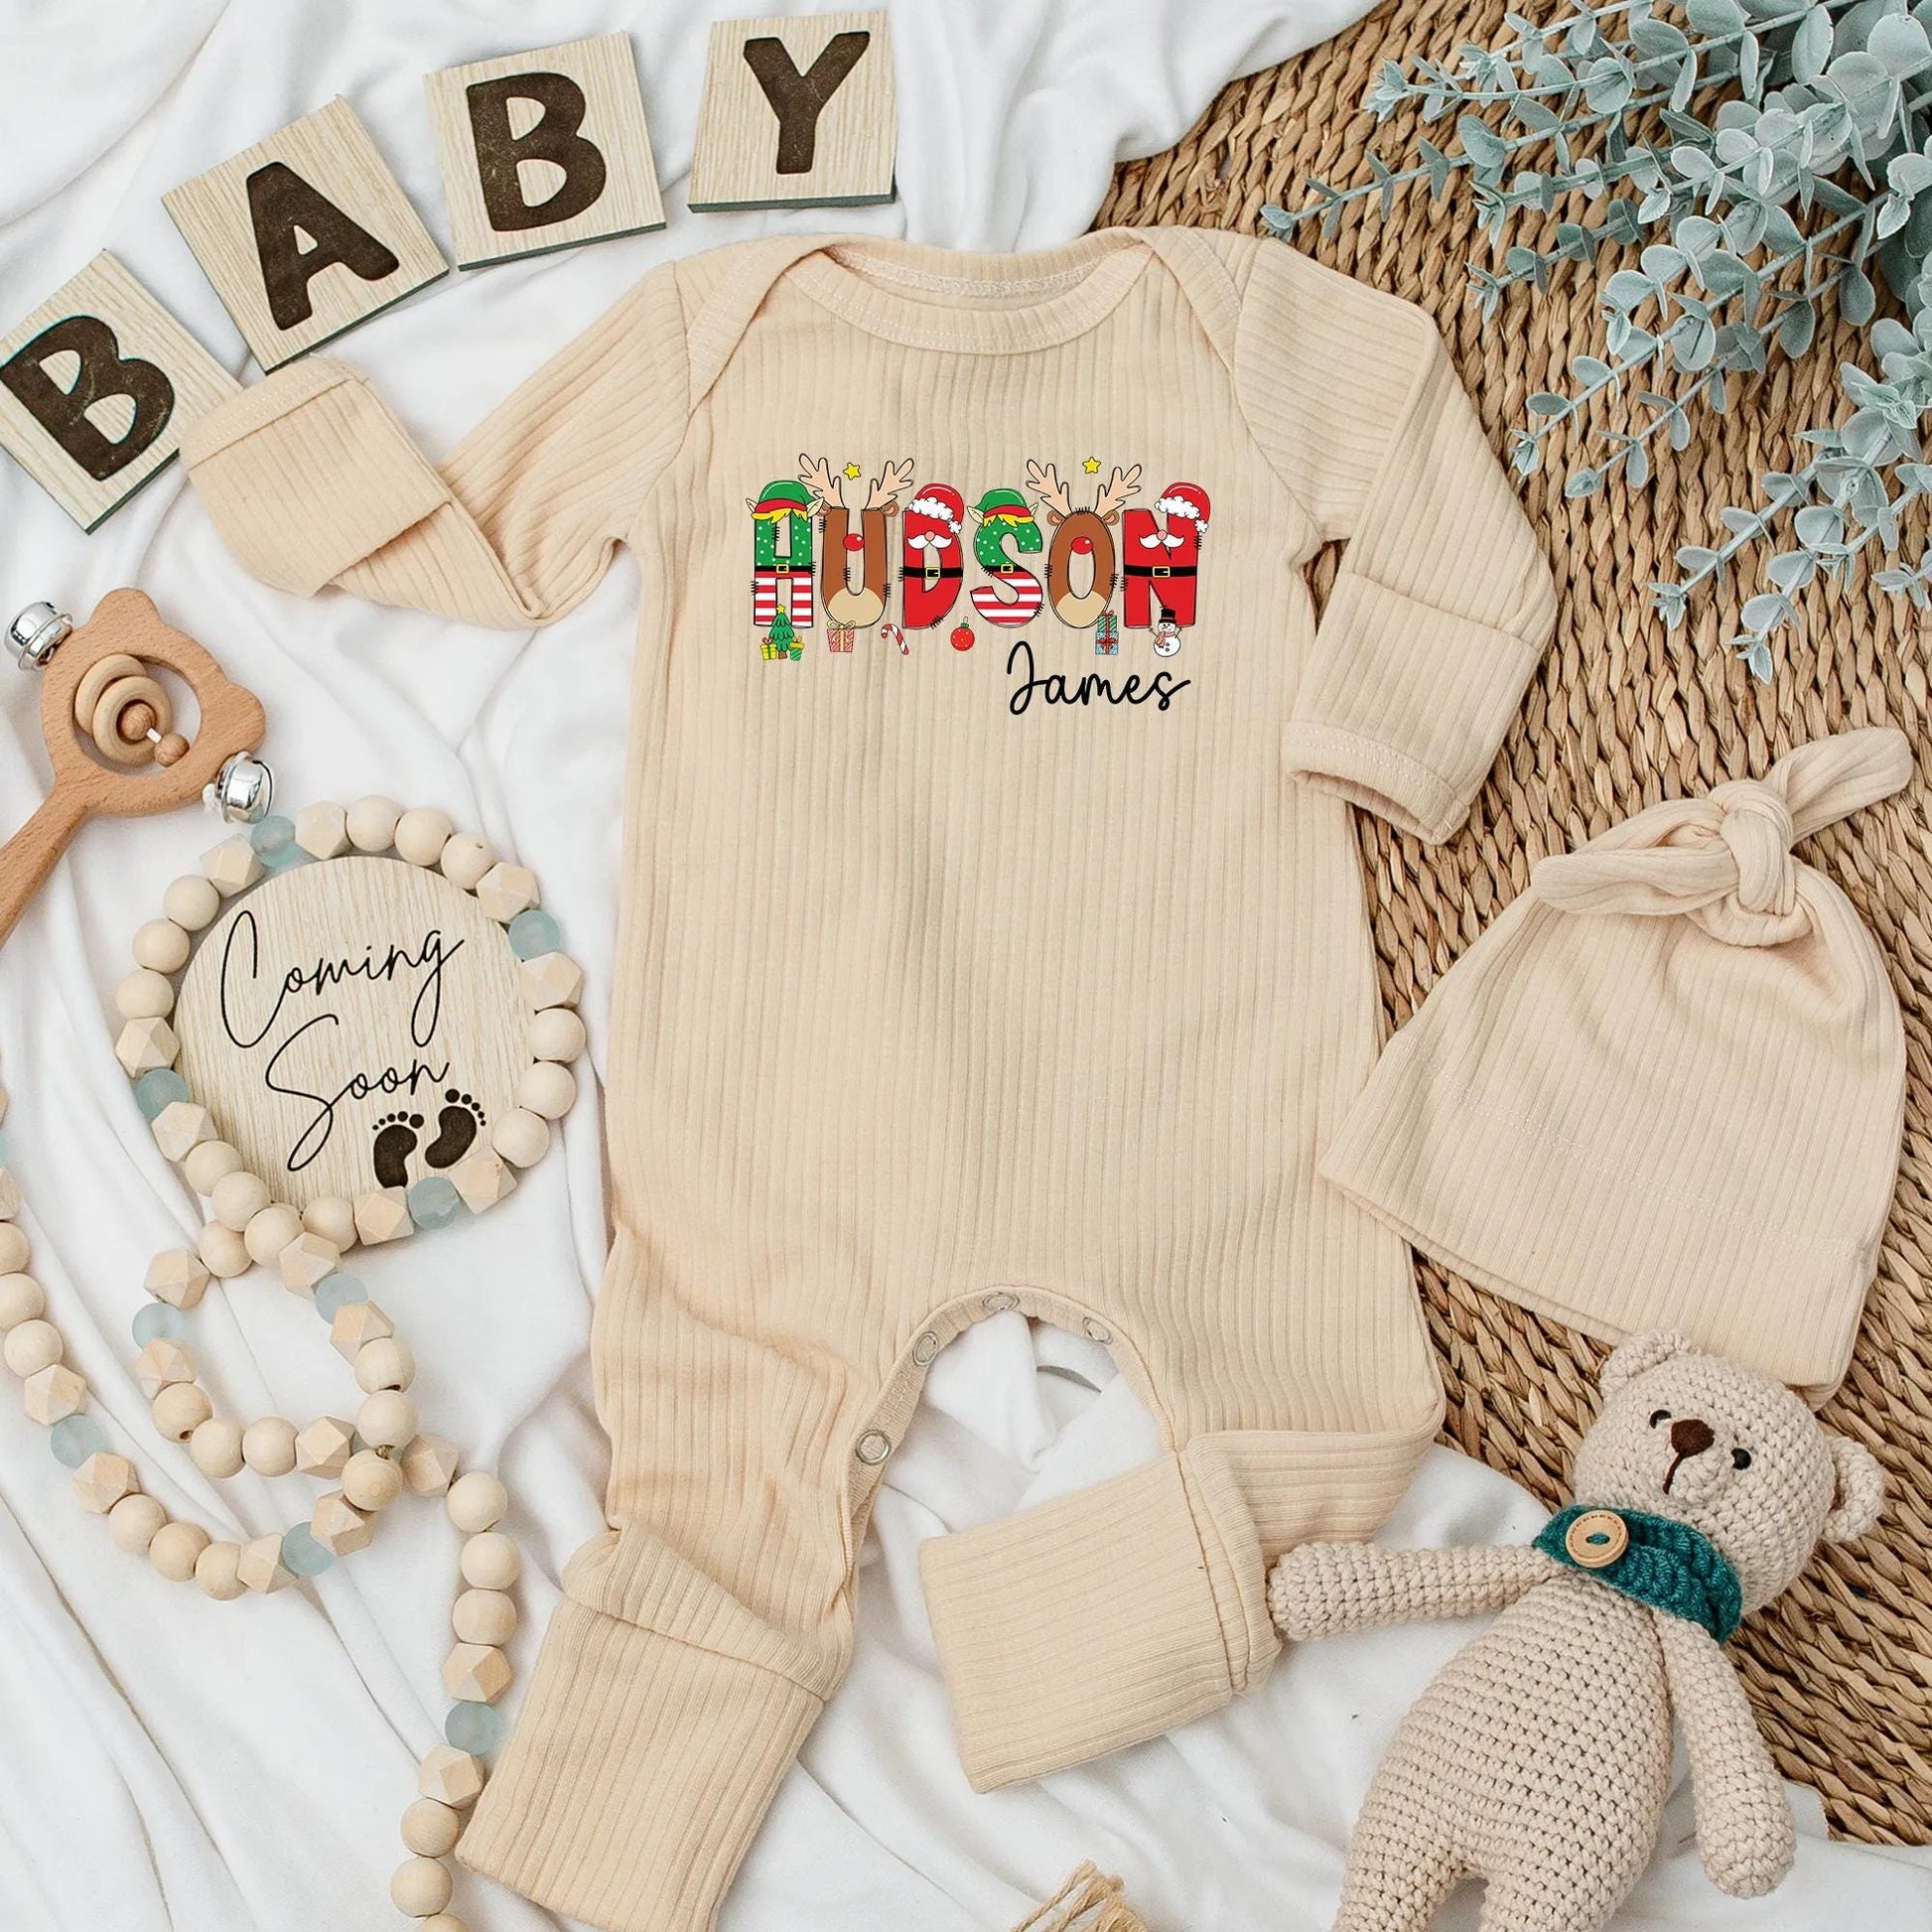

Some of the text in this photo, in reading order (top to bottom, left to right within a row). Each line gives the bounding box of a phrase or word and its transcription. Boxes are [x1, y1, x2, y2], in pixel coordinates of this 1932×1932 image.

[0, 31, 871, 481] BABY
[751, 496, 1203, 629] HUDSON
[1006, 640, 1191, 716] James
[220, 909, 465, 1048] Coming
[265, 1014, 450, 1172] Soon
